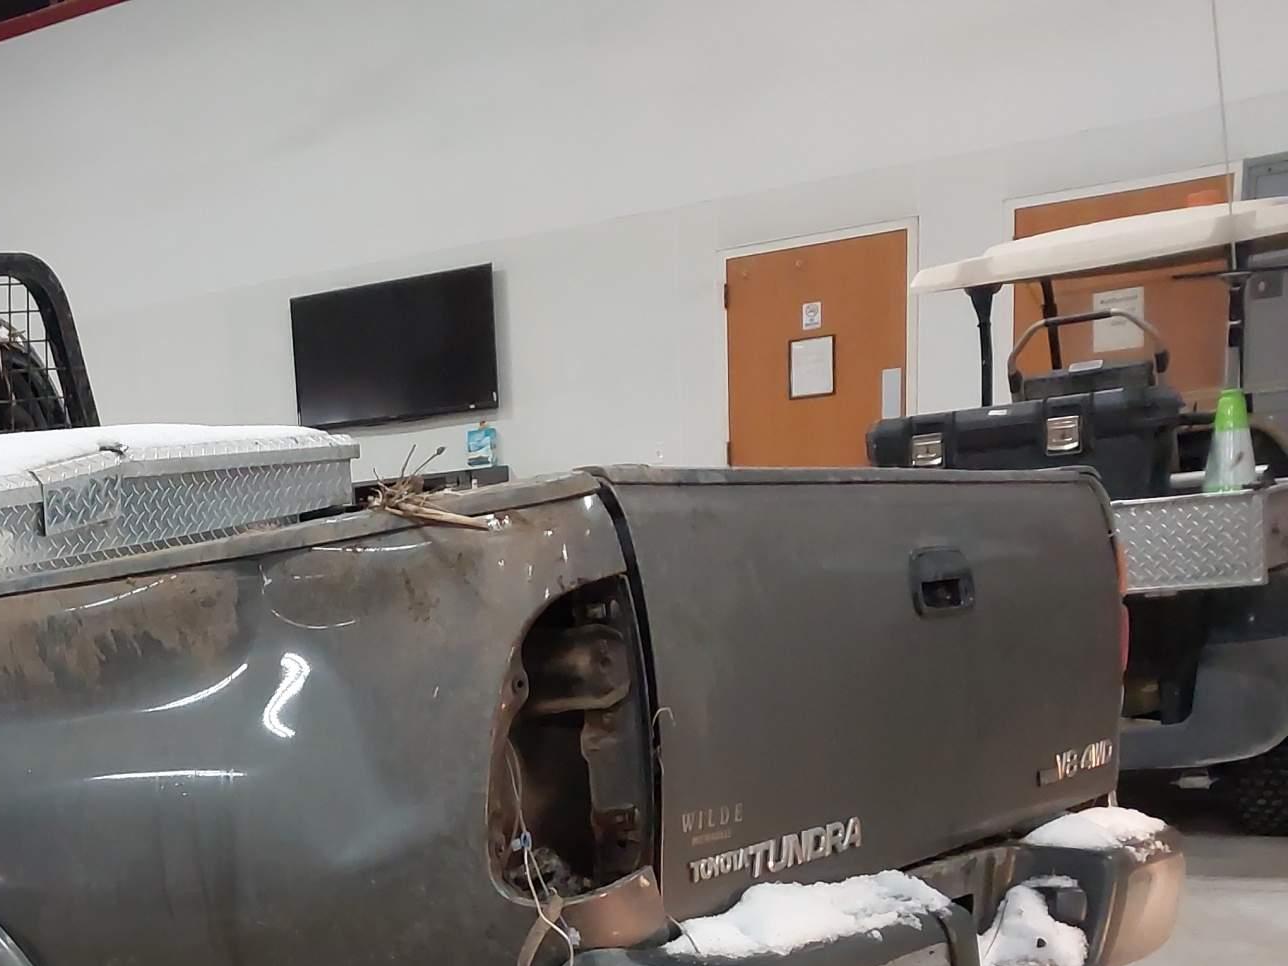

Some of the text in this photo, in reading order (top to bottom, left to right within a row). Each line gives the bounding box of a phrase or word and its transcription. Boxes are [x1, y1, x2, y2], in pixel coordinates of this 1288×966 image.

[1055, 739, 1112, 780] V8 4WD
[682, 803, 743, 832] WILDE
[690, 816, 862, 883] TOYOTA TUNDRA
